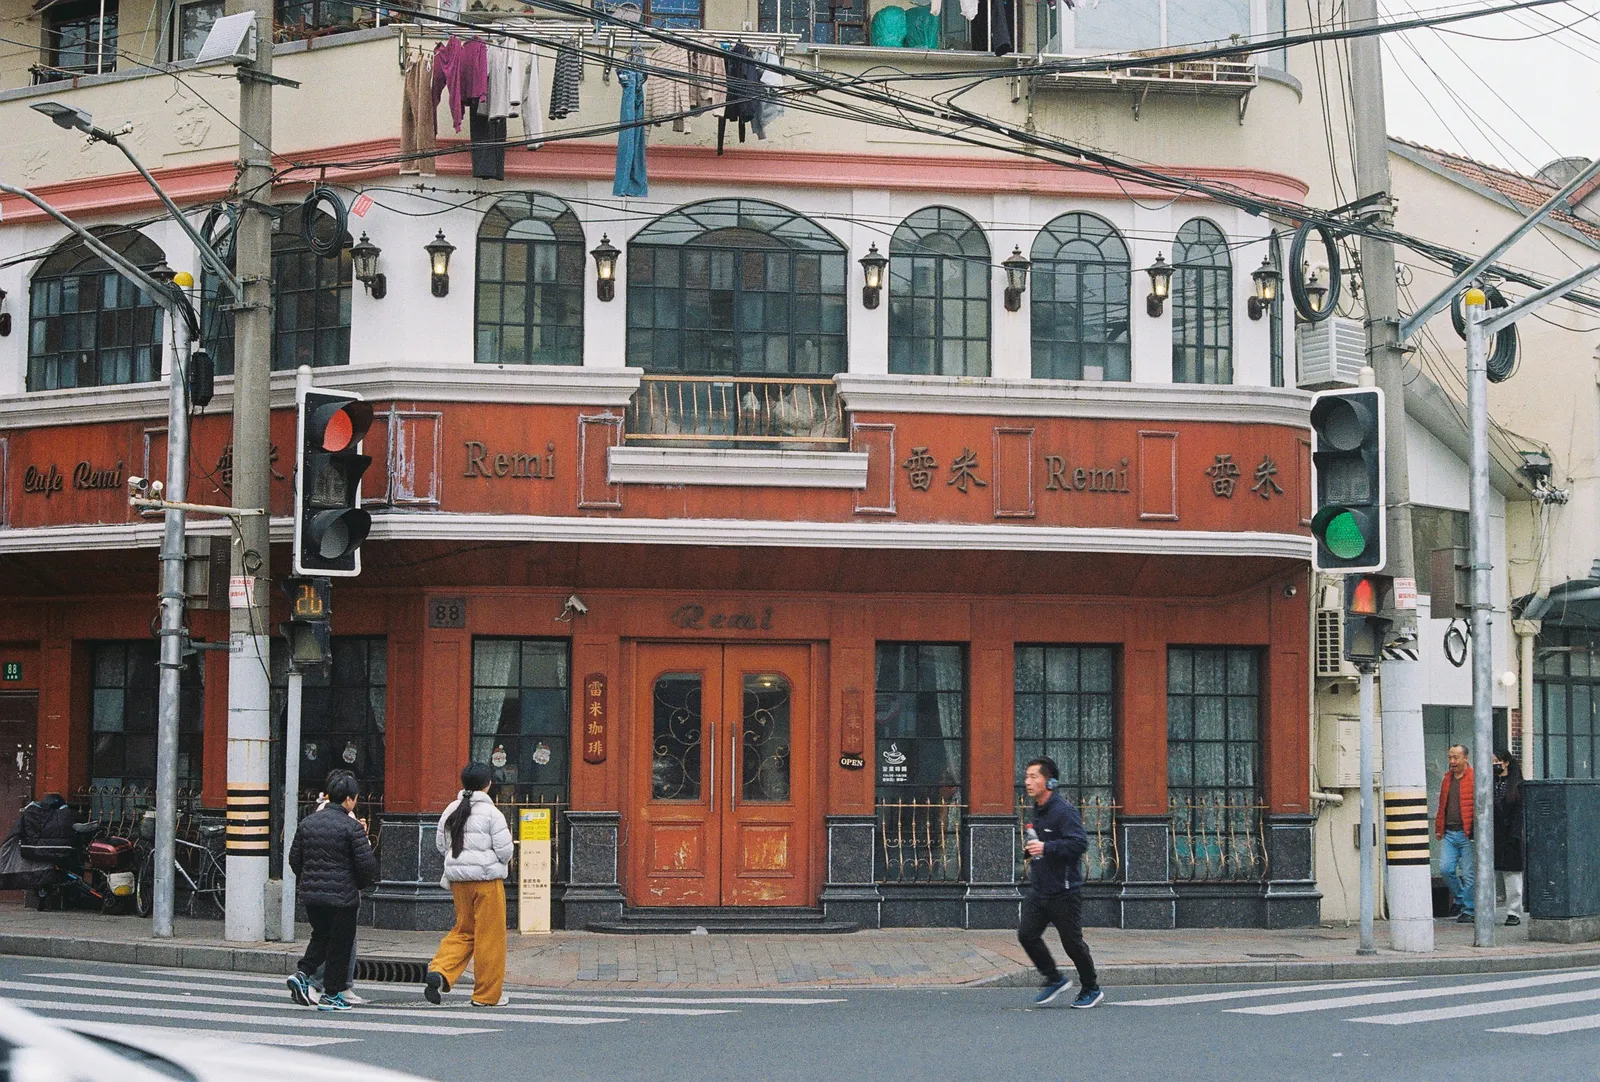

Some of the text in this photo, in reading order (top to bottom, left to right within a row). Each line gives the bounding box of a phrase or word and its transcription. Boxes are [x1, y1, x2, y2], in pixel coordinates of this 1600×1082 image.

[463, 440, 555, 479] Remi
[902, 446, 988, 493] 雷米
[1045, 455, 1131, 493] Remi
[1205, 454, 1284, 500] 雷米
[24, 461, 122, 498] Cafe Remi
[435, 605, 460, 621] 88
[671, 604, 773, 630] Remi
[8, 664, 17, 674] 88
[588, 681, 603, 756] 雷米珈琲
[841, 758, 863, 767] OPEN
